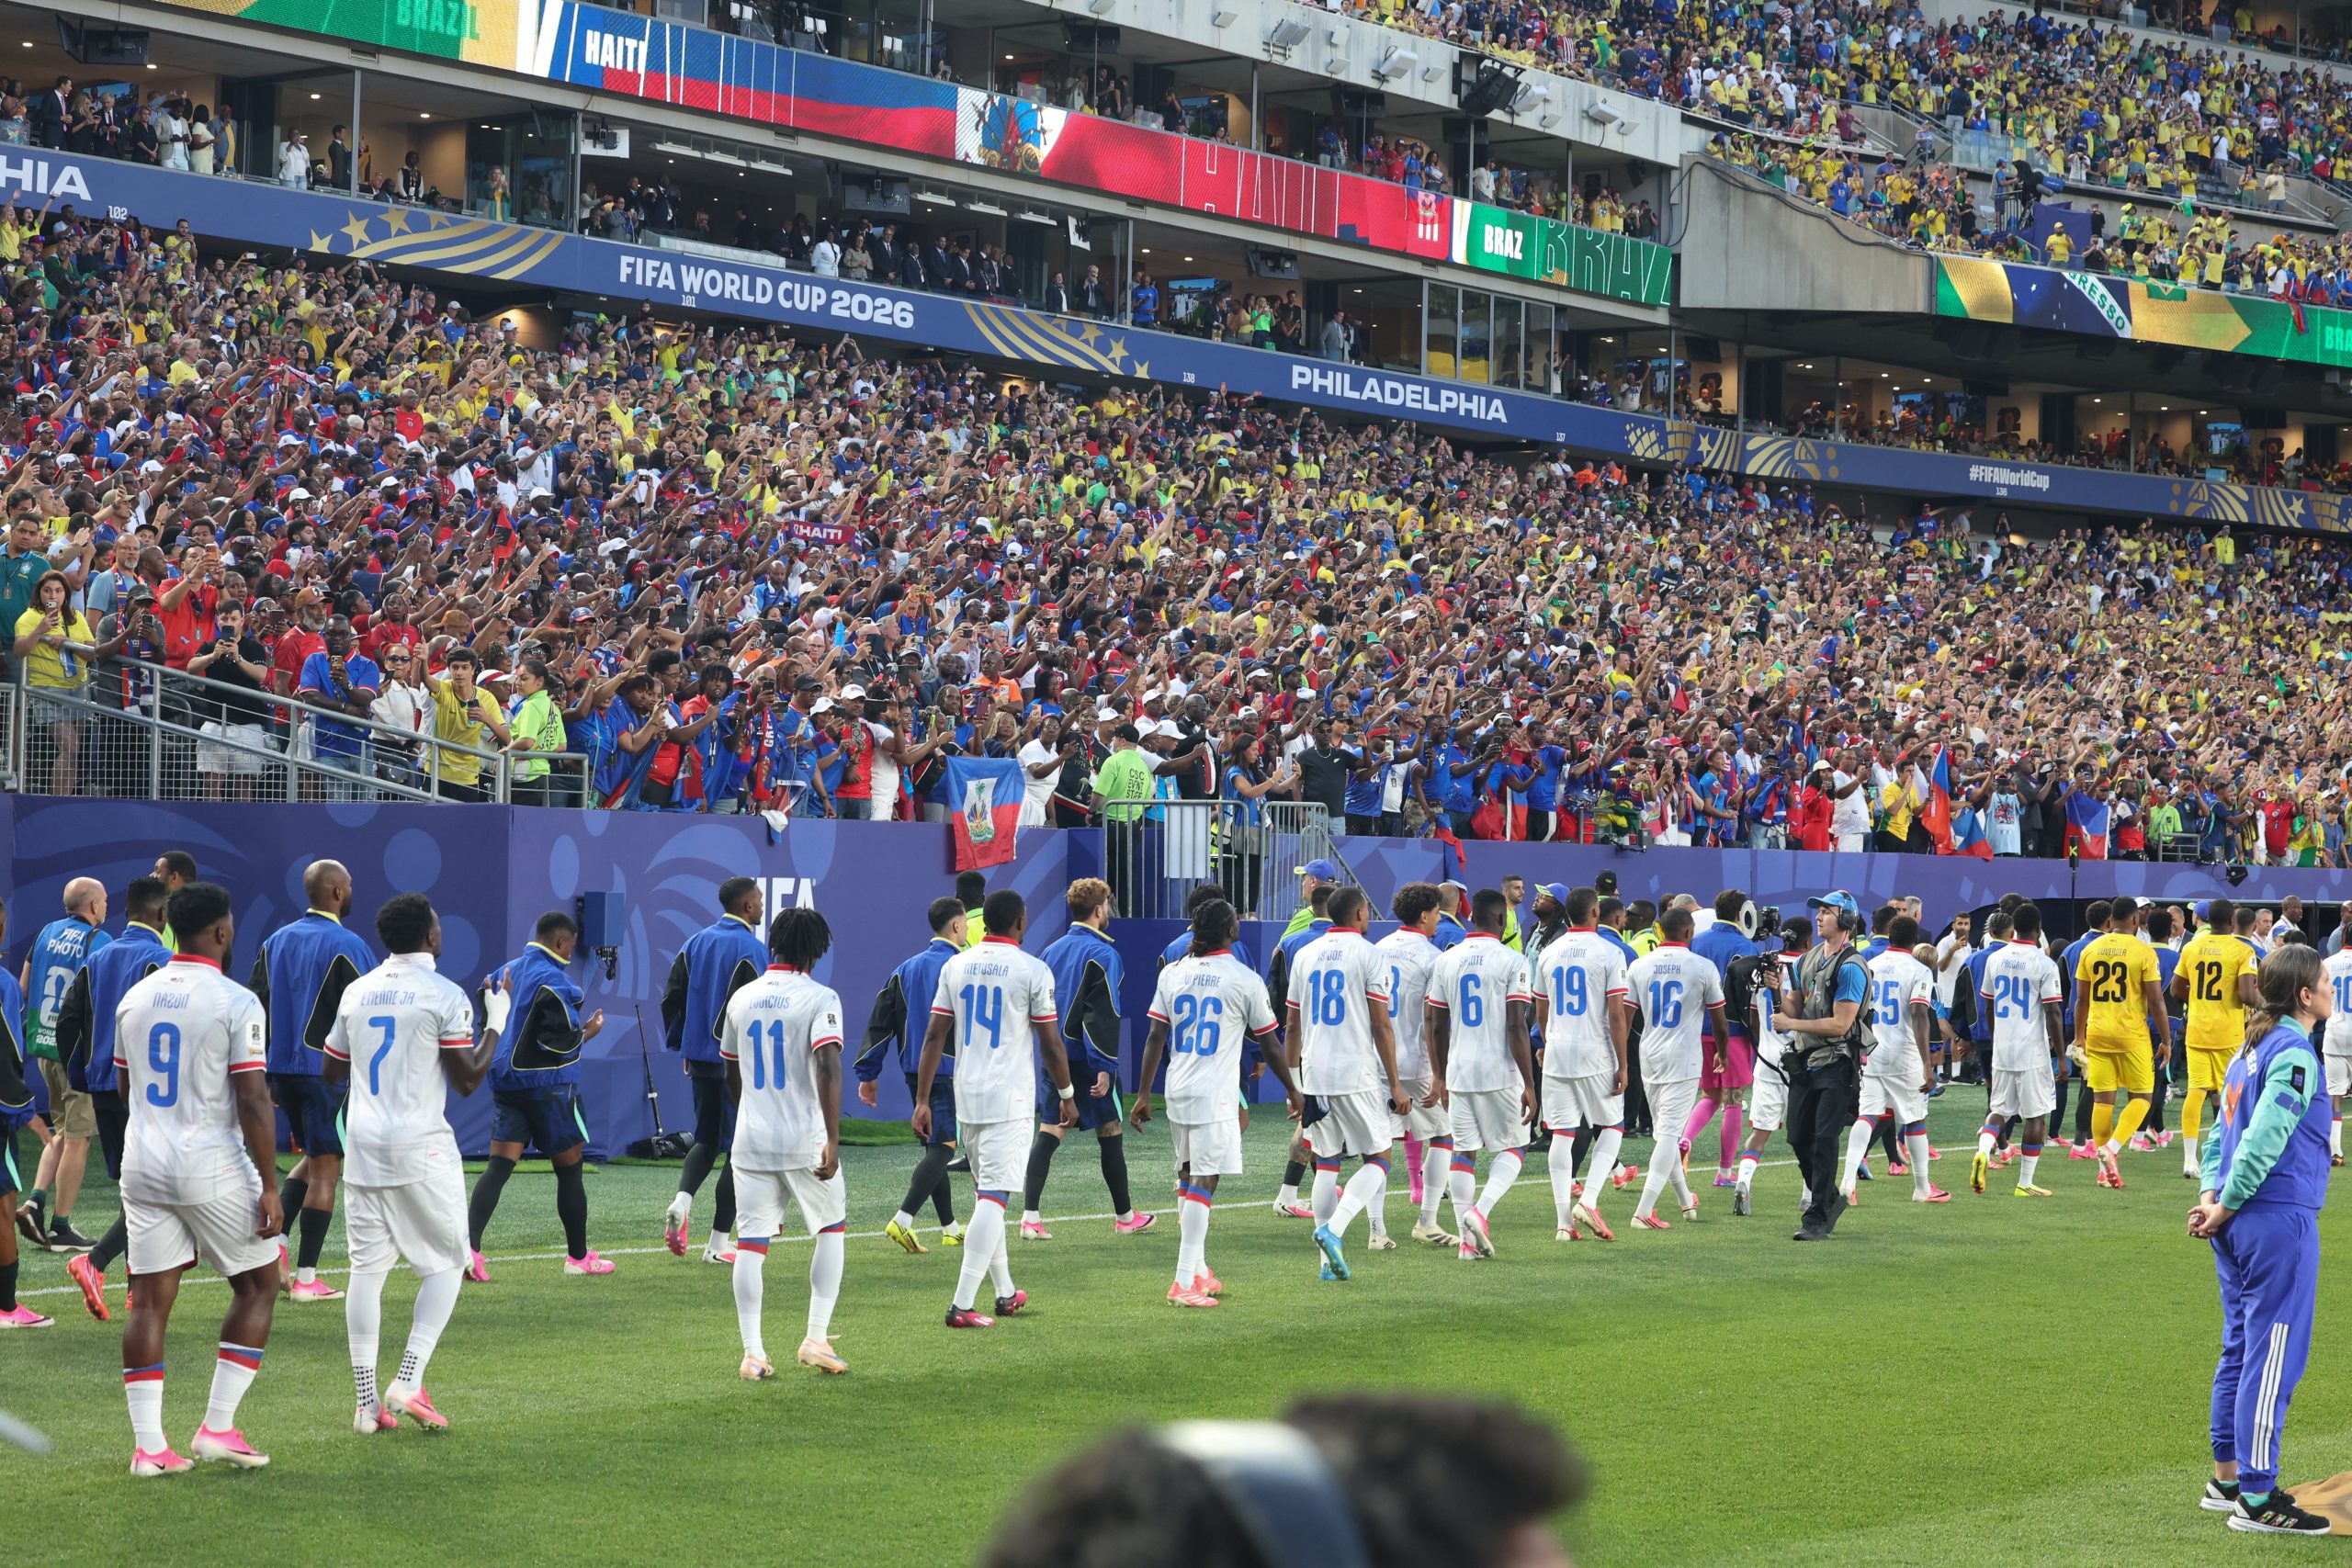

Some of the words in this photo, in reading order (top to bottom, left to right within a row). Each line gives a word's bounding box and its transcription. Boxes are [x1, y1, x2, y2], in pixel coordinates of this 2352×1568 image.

[585, 29, 648, 73] HAITI
[107, 205, 128, 220] 102
[1483, 224, 1523, 259] BRAZ
[619, 254, 675, 290] FIFA
[681, 265, 774, 304] WORLD
[777, 280, 827, 312] CUP
[830, 289, 915, 329] 2026
[681, 295, 696, 308] 101
[1182, 371, 1195, 384] 138
[1292, 365, 1508, 423] PHILADELPHIA
[1555, 432, 1566, 443] 137
[1969, 464, 2050, 491] #FIFAWorldCup
[1996, 487, 2007, 496] 136
[799, 525, 842, 540] HAITI
[1129, 768, 1145, 782] CSC
[732, 877, 816, 944] IFA
[47, 938, 84, 959] PHOTO
[59, 928, 86, 943] FIFA
[964, 963, 1009, 977] METUSALA
[1653, 964, 1681, 975] JOSEPH
[2092, 961, 2127, 1003] 23
[2195, 961, 2222, 1001] 12
[1308, 969, 1345, 1026] 18
[1460, 973, 1483, 1027] 6
[1553, 965, 1588, 1016] 19
[1649, 980, 1683, 1029] 16
[1995, 975, 2030, 1020] 24
[960, 984, 1002, 1049] 14
[1174, 994, 1223, 1056] 26
[36, 1034, 58, 1047] 202
[369, 1016, 395, 1096] 7
[747, 1020, 786, 1090] 11
[146, 1022, 180, 1108] 9
